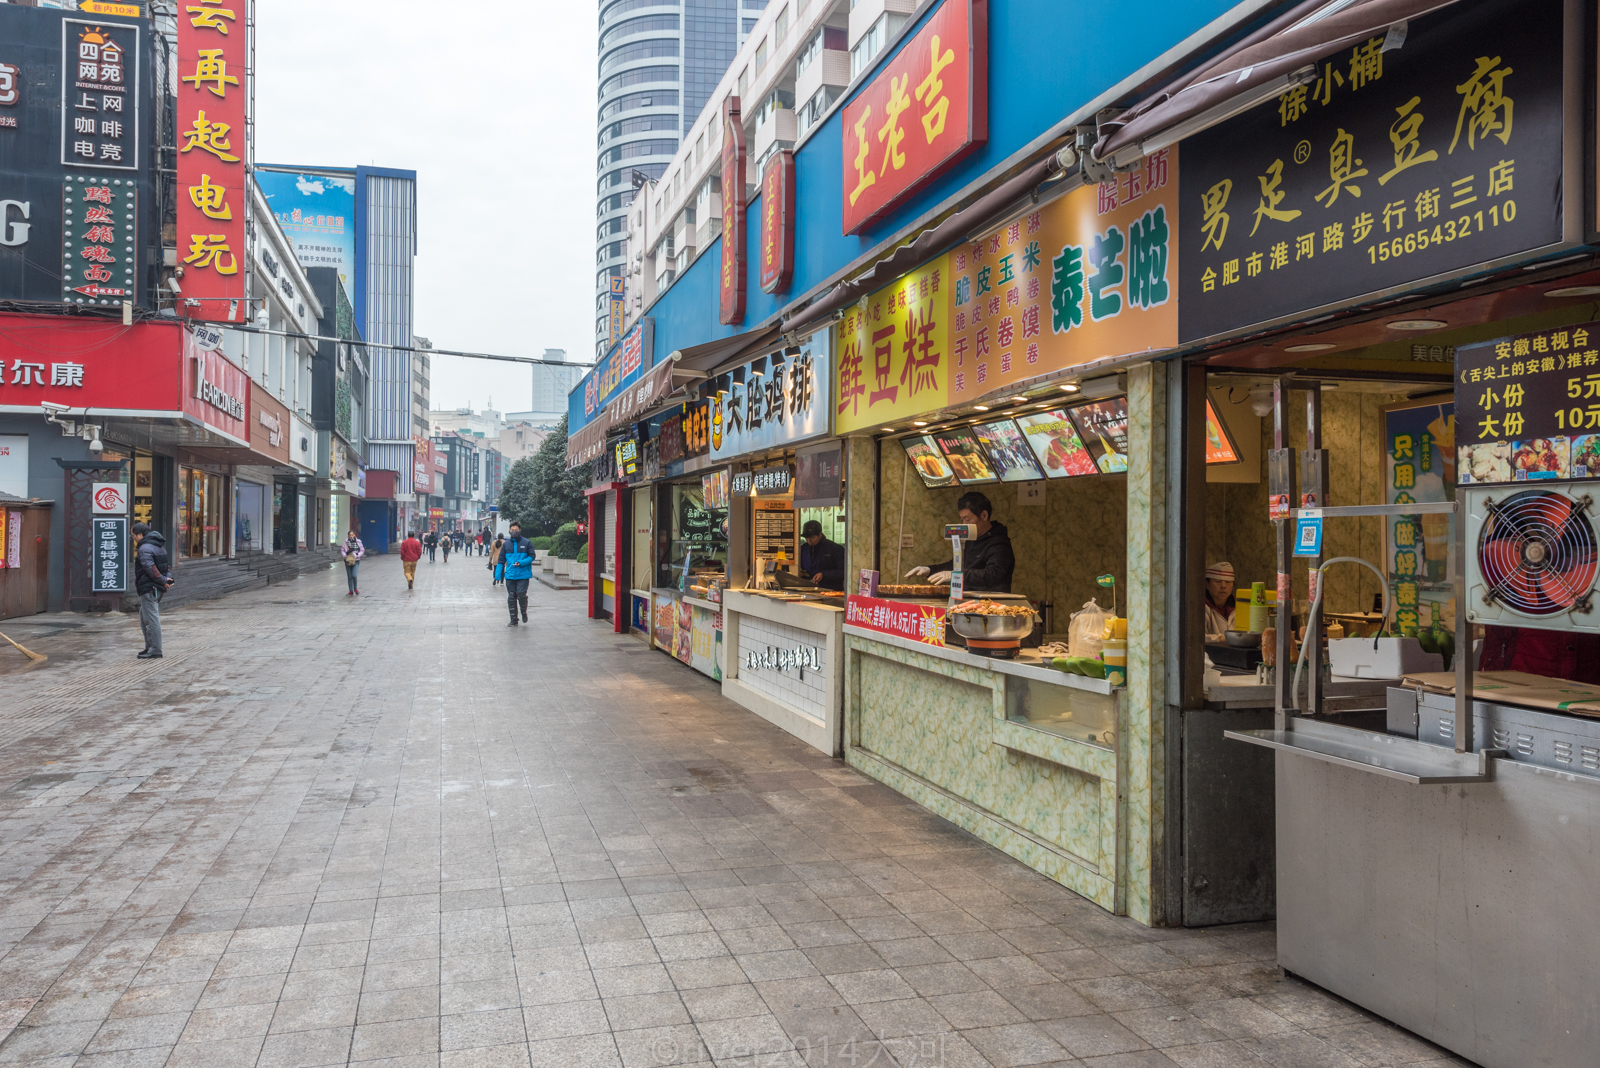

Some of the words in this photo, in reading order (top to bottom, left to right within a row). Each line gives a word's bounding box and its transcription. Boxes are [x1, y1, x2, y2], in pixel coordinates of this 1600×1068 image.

[92, 4, 136, 15] 巷内10米
[75, 81, 103, 90] INTERNET
[75, 92, 122, 112] 上网
[1278, 36, 1384, 127] 徐小楠
[75, 116, 122, 138] 咖啡
[75, 140, 122, 161] 电竞
[849, 34, 955, 207] 王老吉
[81, 186, 116, 284] 黯然销魂面
[723, 178, 732, 289] 王老吉
[765, 173, 775, 267] 王老吉
[955, 210, 1042, 273] 油炸冰淇淋
[1200, 159, 1516, 293] 合肥市淮河路步行街三店
[1367, 199, 1517, 265] 15665432110
[613, 279, 622, 290] 7
[954, 240, 1041, 308] 脆皮玉米
[1051, 203, 1170, 335] 泰芒啦
[839, 308, 882, 340] 北京名小吃
[887, 269, 942, 316] 绝味豆糕香
[954, 276, 1041, 333] 脆皮烤鸭卷
[196, 327, 220, 344] 网咖
[837, 297, 941, 417] 鲜豆糕
[954, 304, 1041, 368] 于氏卷馍
[1494, 327, 1590, 361] 安徽电视台
[0, 359, 85, 387] 尔康
[196, 357, 231, 414] YEARCON
[726, 348, 815, 438] 大脸鸡排
[955, 342, 1040, 393] 芙蓉蛋卷
[1460, 349, 1599, 384] 《舌尖上的安徽》推荐
[1478, 383, 1526, 411] 小份
[1478, 411, 1526, 440] 大份
[100, 521, 119, 589] 哑巴巷特色餐饮
